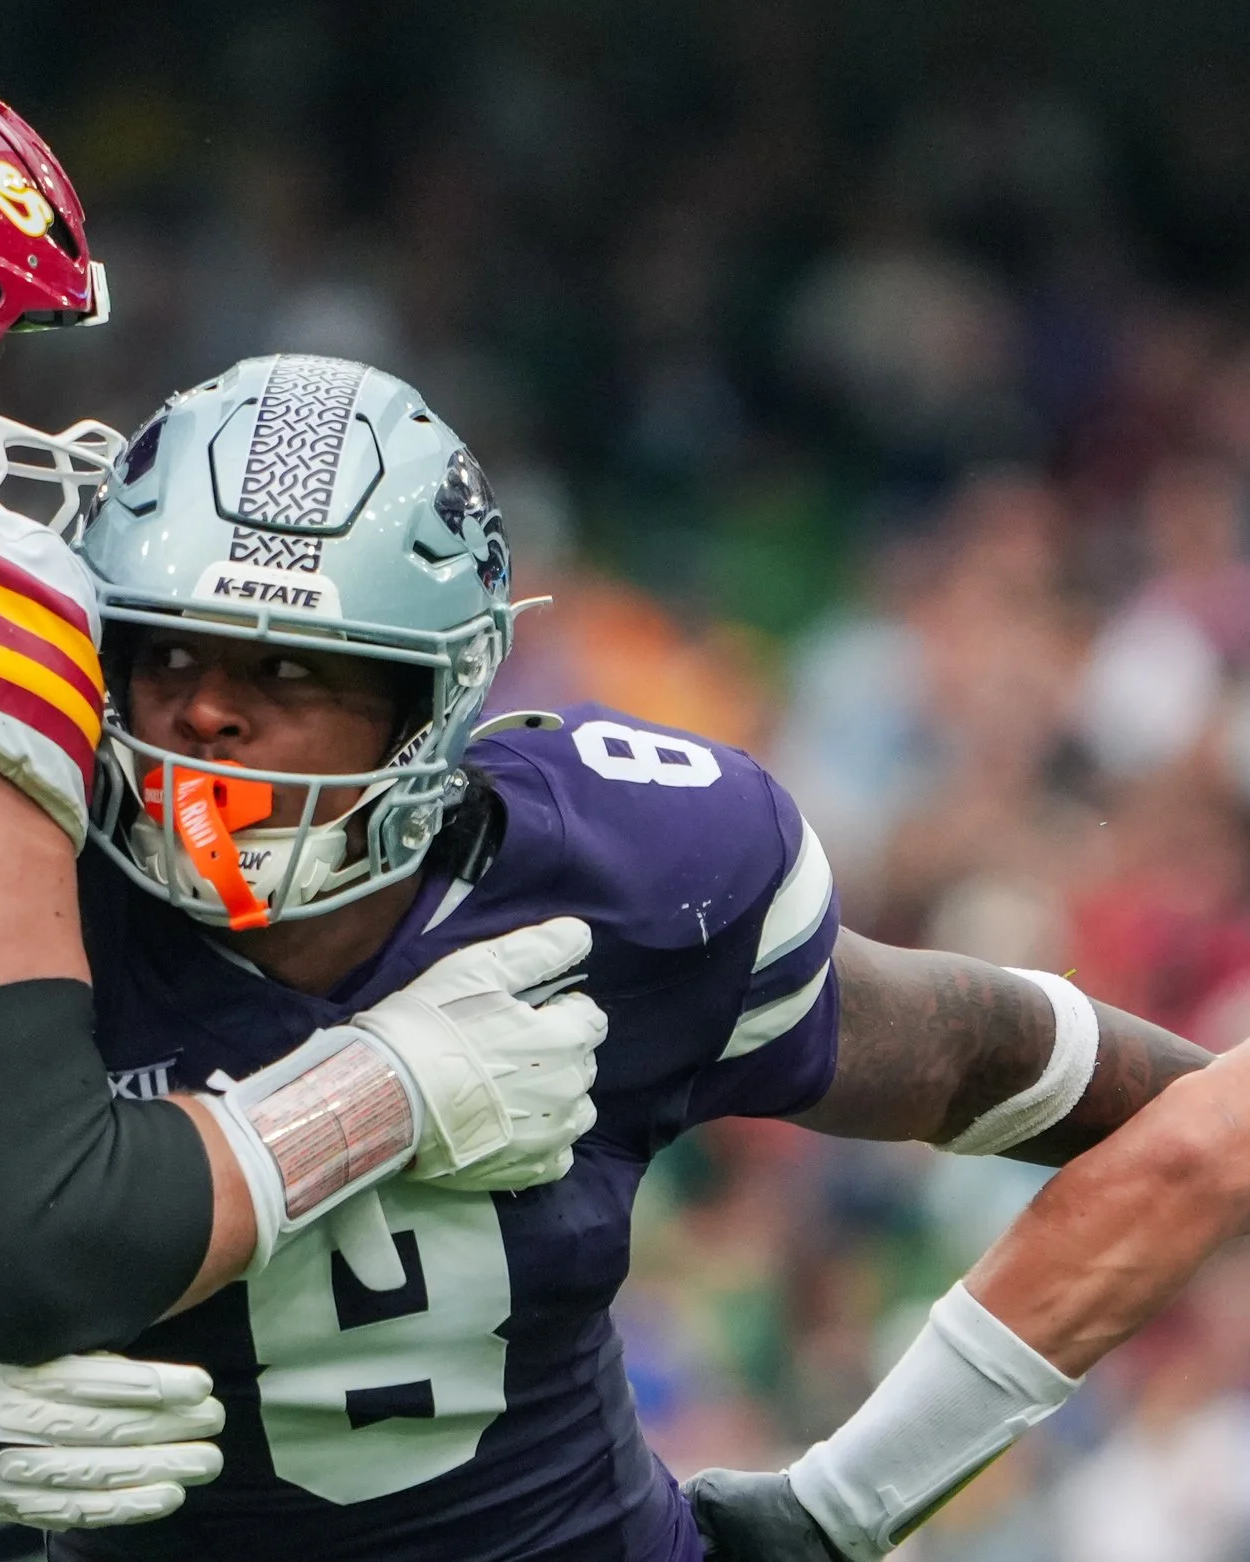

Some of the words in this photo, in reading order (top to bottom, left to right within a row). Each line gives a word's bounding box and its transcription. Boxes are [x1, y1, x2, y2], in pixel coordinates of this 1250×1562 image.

[214, 576, 322, 608] K-STATE
[571, 720, 722, 788] 8
[247, 1183, 511, 1507] 8
